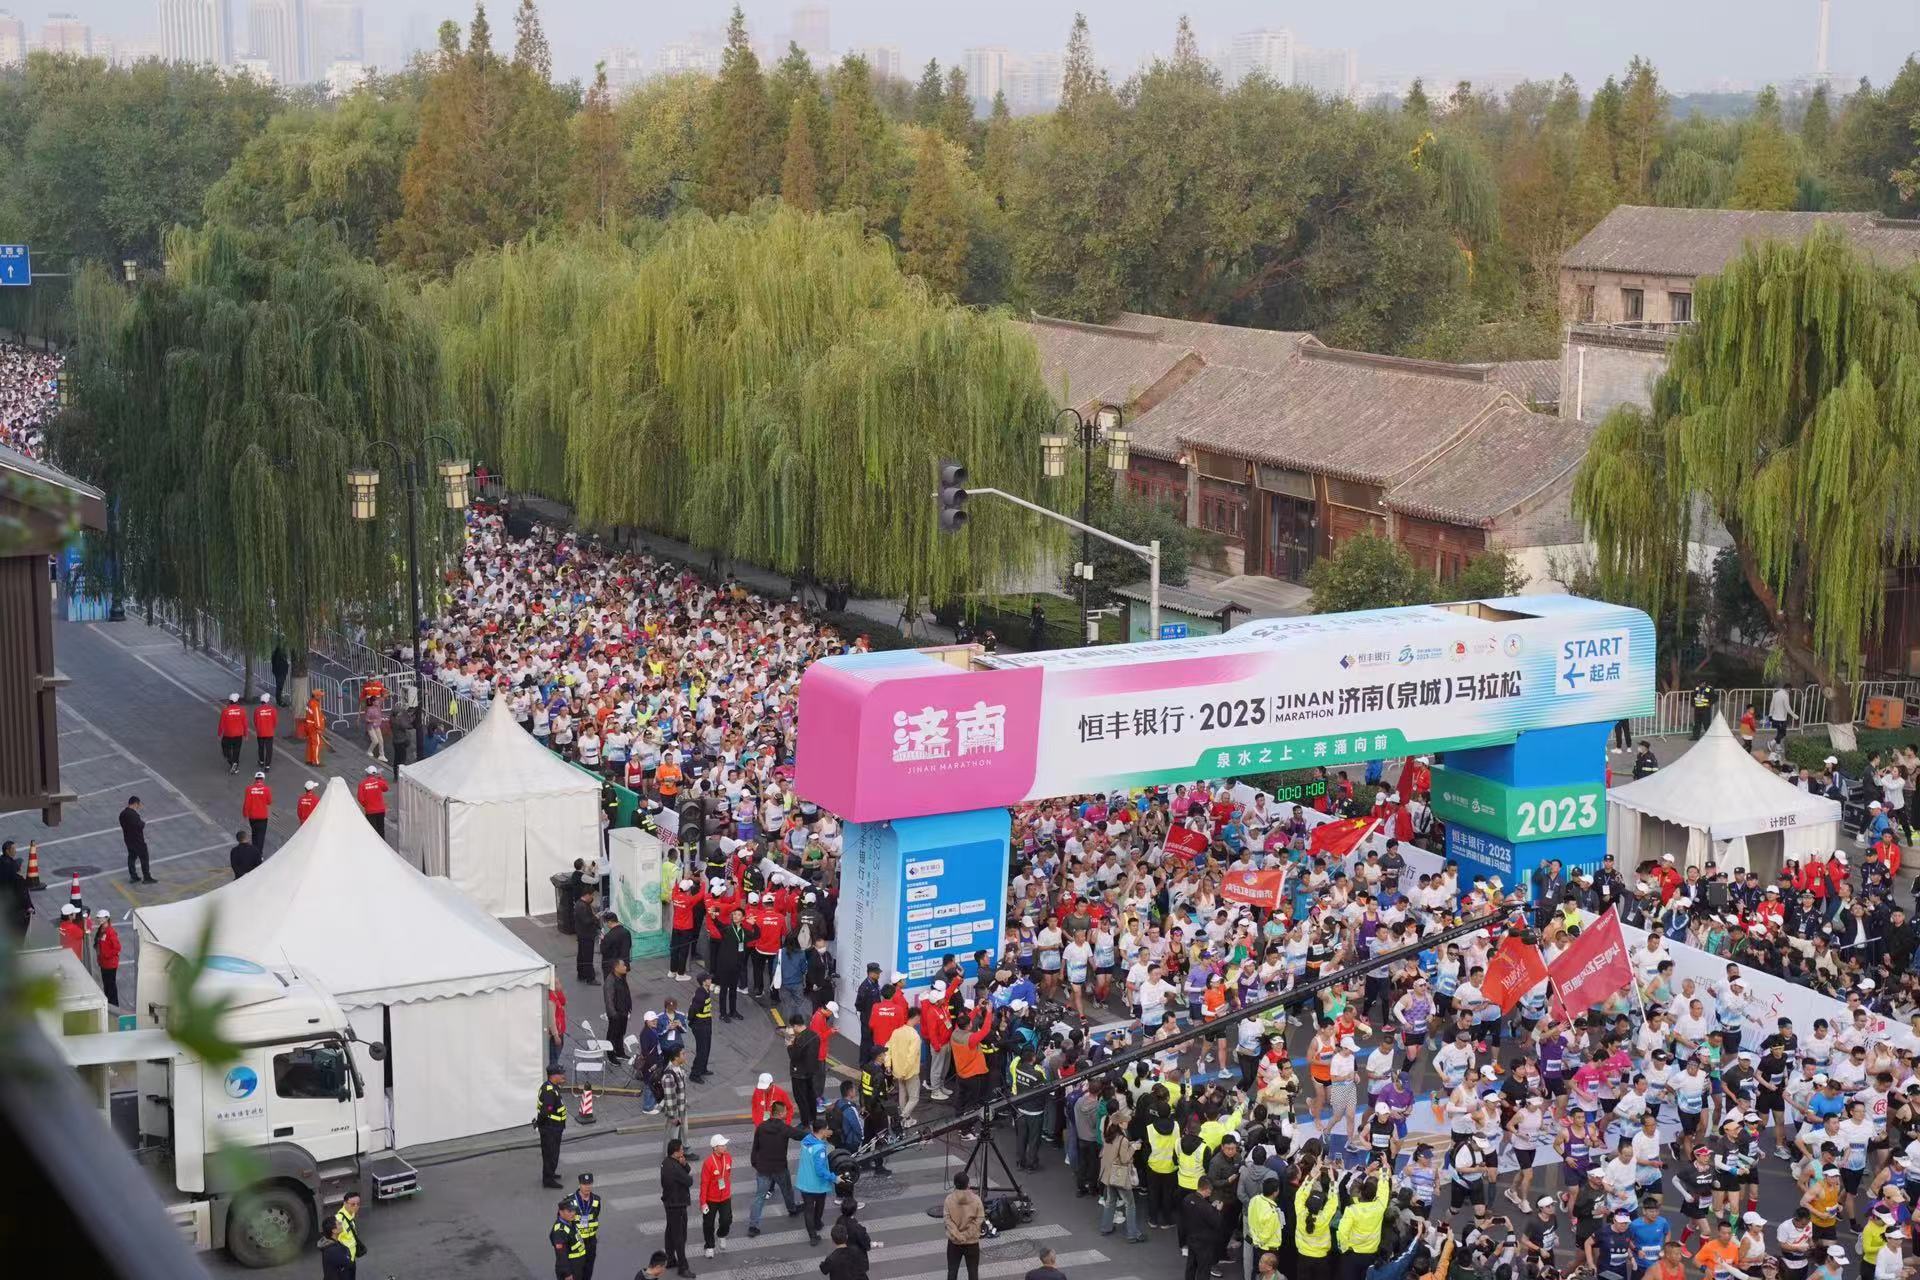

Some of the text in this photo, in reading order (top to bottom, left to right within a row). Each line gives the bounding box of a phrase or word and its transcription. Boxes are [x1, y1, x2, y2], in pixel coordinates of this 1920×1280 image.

[1358, 650, 1391, 664] 恒丰银行
[1563, 636, 1623, 661] START
[1588, 661, 1621, 683] 起点
[1276, 689, 1335, 710] JINAN
[1337, 670, 1523, 715] 济南(泉城)马拉松
[1275, 708, 1334, 723] MARATHON
[892, 701, 1006, 763] 济南
[907, 759, 992, 774] JINAN MARATHON
[1277, 782, 1326, 801] 00:01:08
[1516, 794, 1598, 837] 2023
[1770, 815, 1797, 829] 计时区
